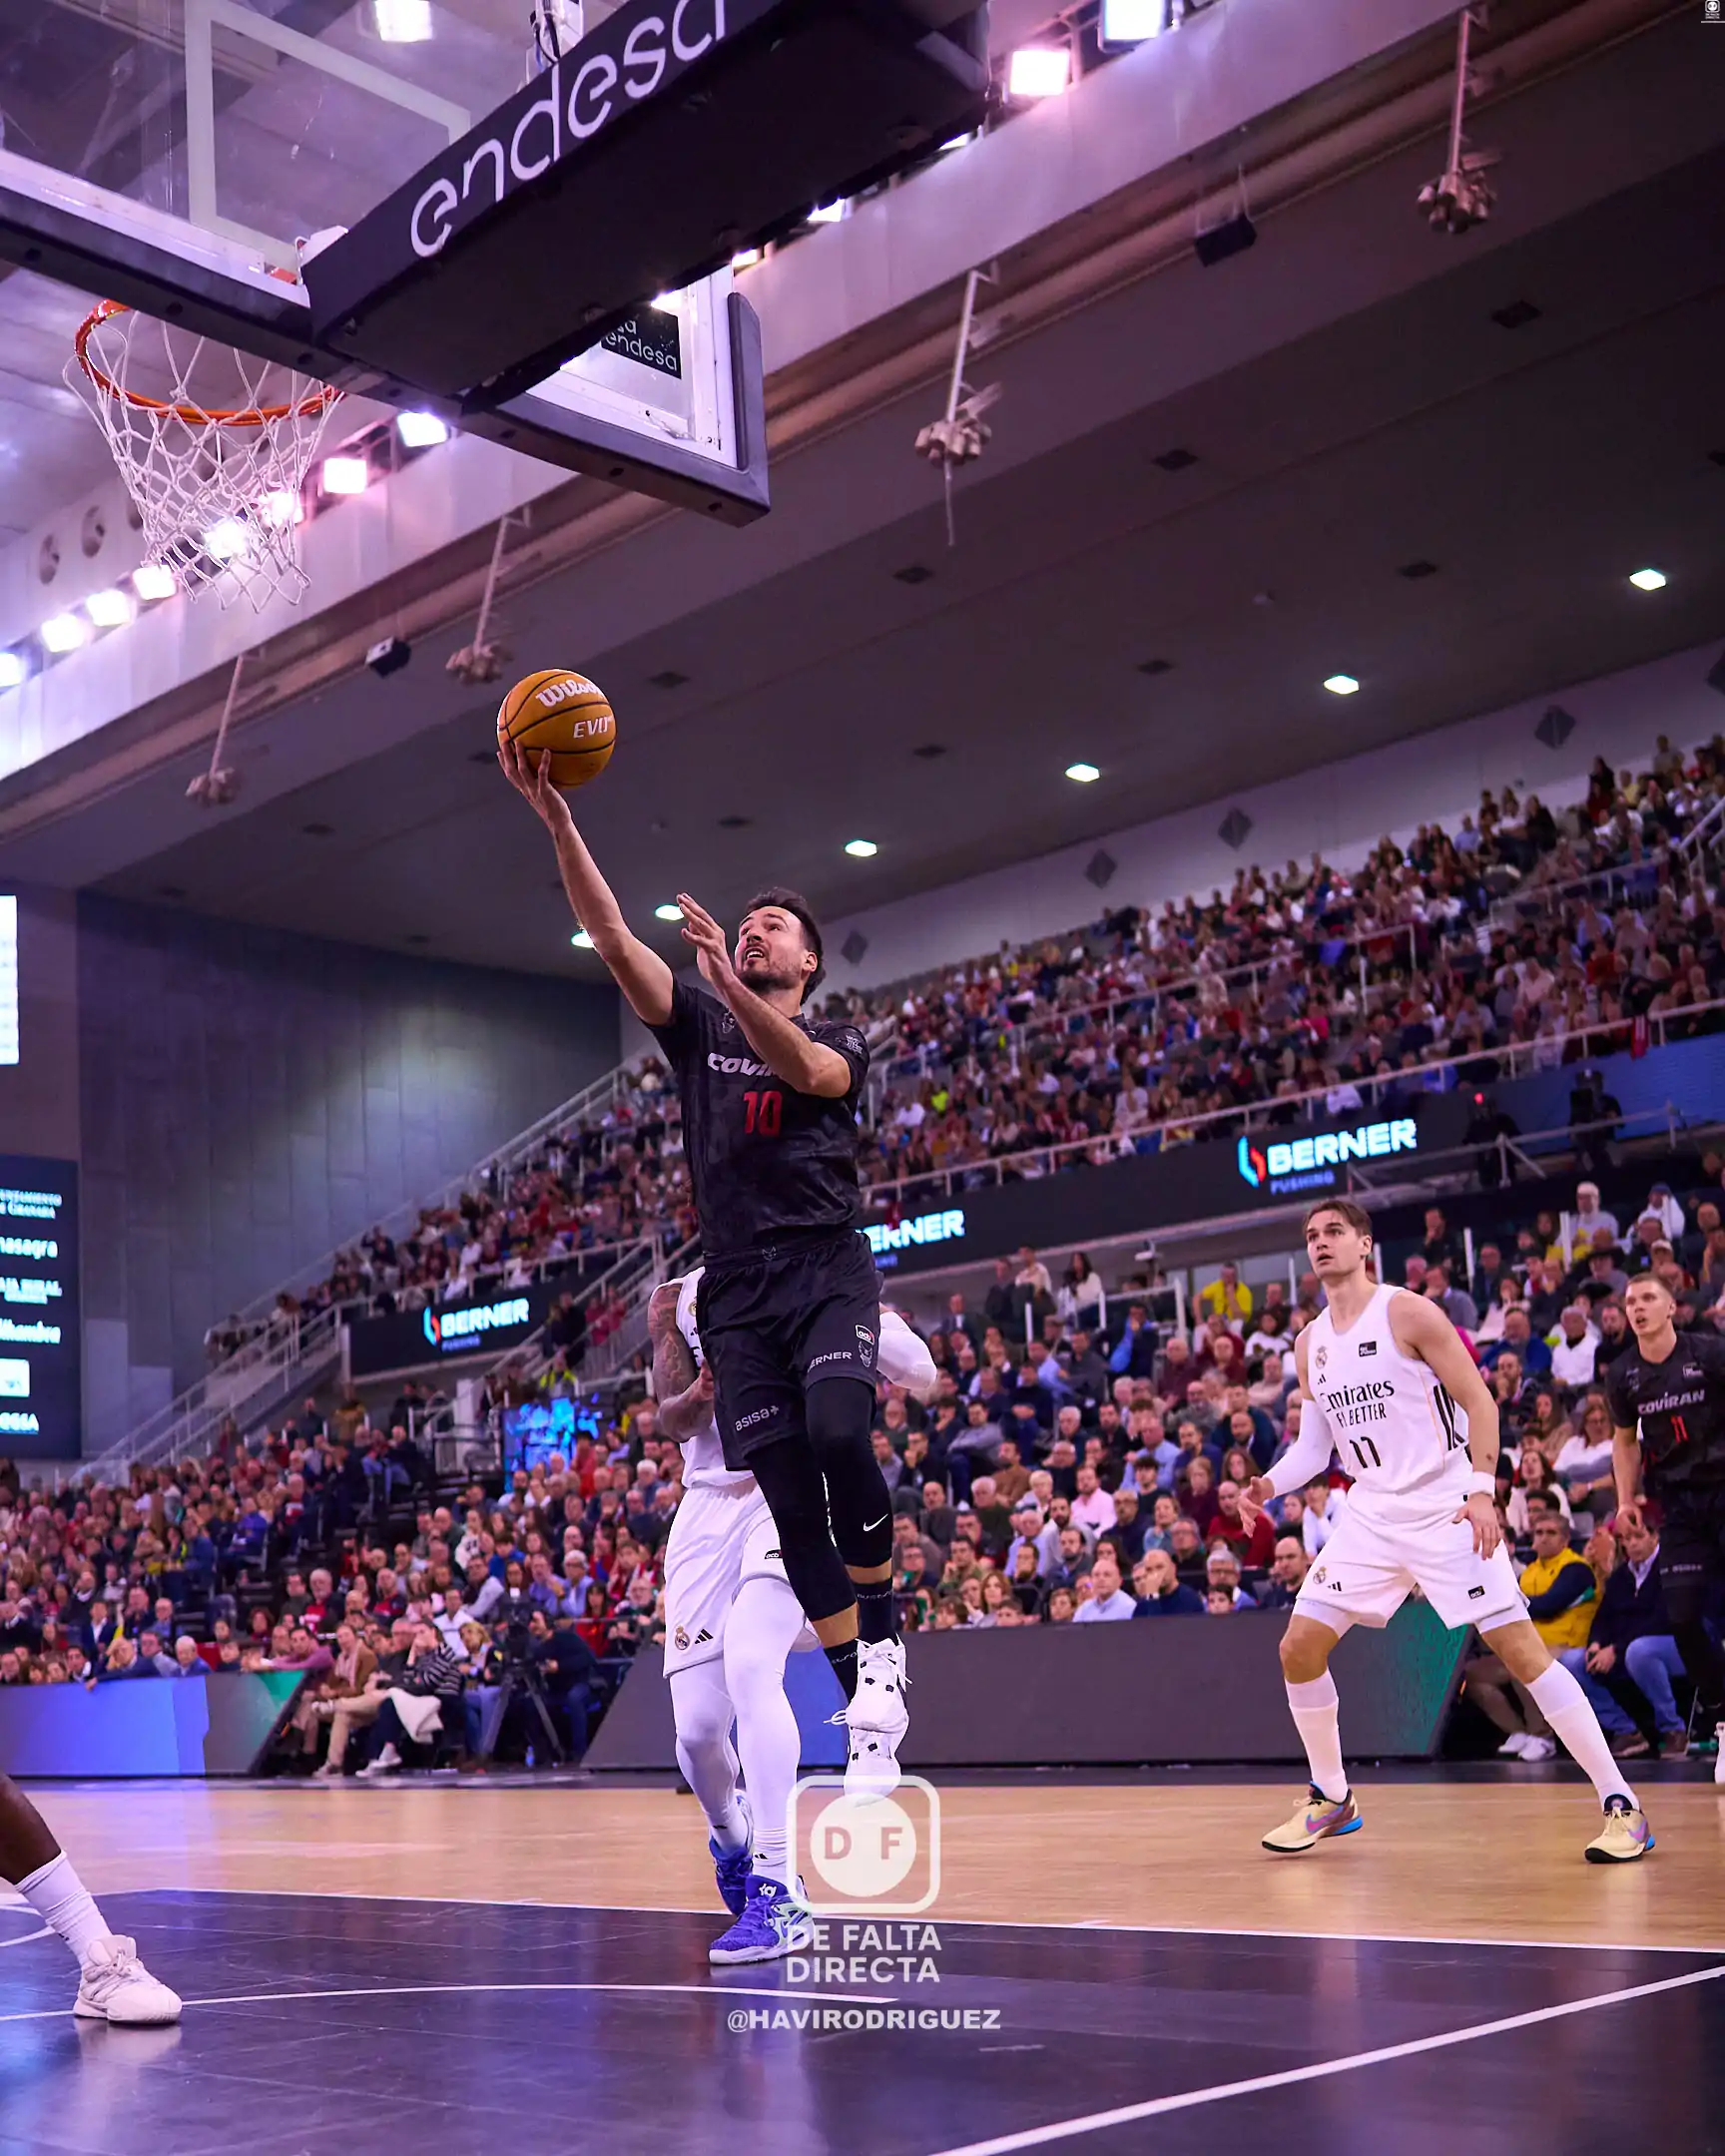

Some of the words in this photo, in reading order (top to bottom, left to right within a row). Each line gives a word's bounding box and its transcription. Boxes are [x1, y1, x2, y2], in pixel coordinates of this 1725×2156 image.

[410, 0, 725, 257] endesa
[605, 330, 677, 371] endesa
[744, 1090, 783, 1137] 10
[1268, 1119, 1417, 1176] BERNER
[856, 1210, 964, 1253] ERNER
[441, 1298, 529, 1338] BERNER
[1350, 1402, 1387, 1425] BETTER
